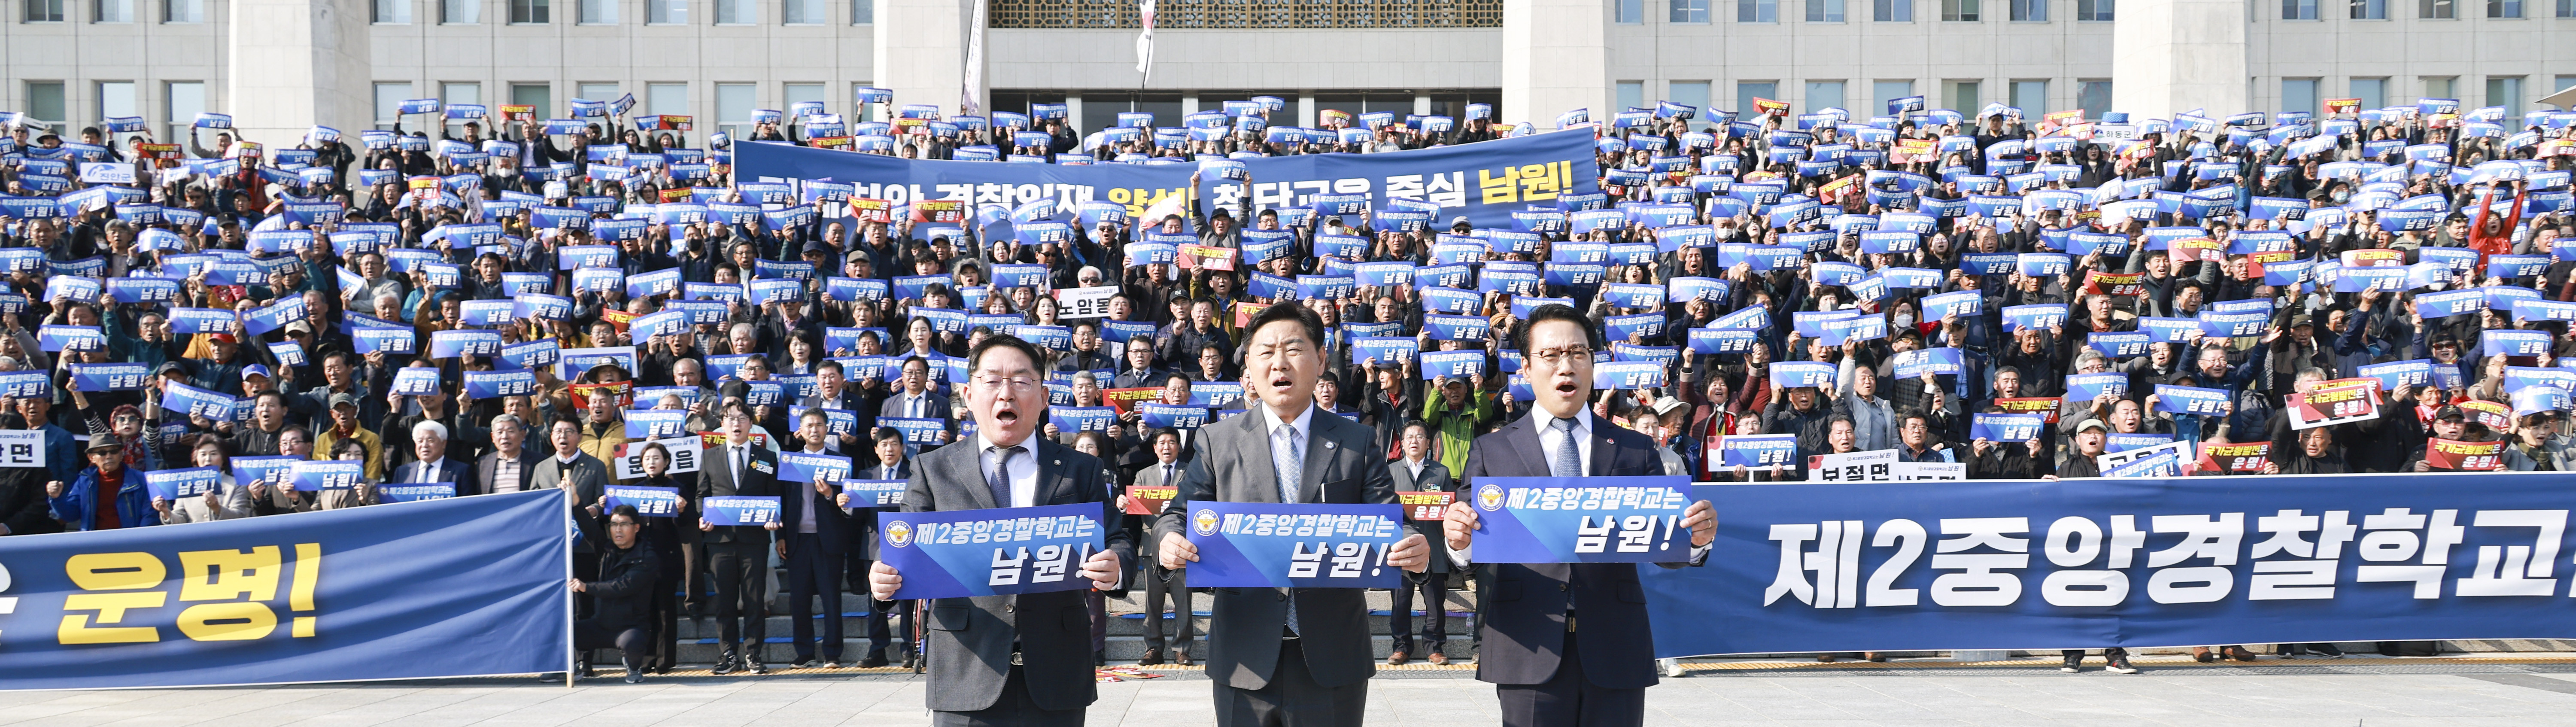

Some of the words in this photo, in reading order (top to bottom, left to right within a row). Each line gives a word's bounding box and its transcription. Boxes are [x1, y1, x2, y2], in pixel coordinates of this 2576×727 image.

[1905, 103, 1921, 111] 남원!
[2106, 130, 2131, 138] 하동군
[100, 172, 131, 181] 진안군
[1221, 168, 1245, 178] 남원!
[1479, 160, 1572, 205] 남원!
[1754, 192, 1778, 203] 남원!
[1977, 196, 2021, 204] 제2중앙경찰학교는
[915, 202, 962, 210] 국가균형발전은
[1338, 203, 1363, 213] 남원!
[2260, 200, 2309, 208] 제2중앙경찰학교는
[25, 206, 53, 217] 남원!
[935, 210, 960, 221] 운명!
[1100, 210, 1124, 221] 남원!
[1994, 205, 2020, 216] 남원!
[2279, 208, 2305, 219] 남원!
[2387, 211, 2434, 219] 제2중앙경찰학교는
[1401, 219, 1425, 230] 남원!
[1667, 214, 1692, 225] 남원!
[2406, 219, 2433, 229] 남원!
[619, 228, 644, 238] 남원!
[2077, 234, 2127, 244] 제2중앙경찰학교는
[1888, 240, 1915, 250] 남원!
[2257, 241, 2286, 252] 남원!
[1183, 247, 1232, 259] 국가균형발전은
[1340, 245, 1365, 257] 남원!
[1580, 252, 1607, 262] 남원!
[1204, 258, 1229, 269] 운명!
[1554, 264, 1603, 272] 제2중앙경찰학교는
[999, 266, 1045, 274] 제2중앙경찰학교는
[2348, 269, 2406, 277] 제2중앙경찰학교는
[1019, 274, 1044, 285] 남원!
[1306, 277, 1354, 286] 제2중앙경찰학교는
[1384, 273, 1411, 283] 남원!
[1573, 272, 1600, 283] 남원!
[2092, 274, 2142, 284] 국가균형발전은
[2371, 277, 2403, 289] 남원!
[653, 278, 678, 293] 남원!
[837, 279, 886, 289] 제2중앙경찰학교는
[2112, 284, 2140, 294] 운명!
[141, 288, 173, 299] 남원!
[855, 289, 884, 301] 남원!
[1325, 286, 1352, 297] 남원!
[2427, 290, 2483, 304] 제2중앙경찰학교는
[1929, 293, 1978, 305] 제2중앙경찰학교는
[1947, 302, 1976, 314] 남원!
[2451, 298, 2482, 313] 남원!
[695, 310, 724, 323] 남원!
[918, 309, 966, 320] 제2중앙경찰학교는
[2013, 307, 2066, 316] 제2중앙경찰학교는
[1434, 317, 1487, 327] 제2중앙경찰학교는
[1616, 314, 1663, 325] 제2중앙경찰학교는
[1829, 317, 1881, 329] 제2중앙경찰학교는
[2034, 315, 2064, 329] 남원!
[2211, 313, 2266, 322] 제2중앙경찰학교는
[655, 320, 683, 335] 남원!
[937, 319, 964, 332] 남원!
[1637, 323, 1662, 337] 남원!
[2233, 322, 2263, 335] 남원!
[442, 332, 499, 341] 제2중앙경찰학교는
[1455, 327, 1483, 339] 남원!
[1850, 326, 1881, 341] 남원!
[2497, 332, 2549, 341] 제2중앙경찰학교는
[464, 341, 497, 354] 남원!
[1720, 338, 1752, 351] 남원!
[2118, 342, 2148, 354] 남원!
[2518, 341, 2548, 354] 남원!
[1384, 348, 1413, 361] 남원!
[1431, 352, 1483, 363] 제2중앙경찰학교는
[82, 365, 146, 374] 제2중앙경찰학교는
[1453, 362, 1482, 374] 남원!
[1604, 363, 1661, 372] 제2중앙경찰학교는
[2372, 363, 2428, 374] 제2중앙경찰학교는
[109, 374, 144, 387] 남원!
[1626, 372, 1657, 385] 남원!
[2398, 371, 2427, 384] 남원!
[173, 387, 231, 405] 제2중앙경찰학교는
[1109, 391, 1163, 400] 국가균형발전은
[2166, 388, 2225, 400] 제2중앙경찰학교는
[2304, 389, 2365, 405] 국가균형발전은
[191, 399, 228, 420] 남원!
[2187, 398, 2222, 413] 남원!
[2334, 400, 2364, 414] 운명!
[1059, 408, 1113, 417] 제2중앙경찰학교는
[1152, 406, 1206, 417] 제2중앙경찰학교는
[887, 420, 942, 429] 제2중앙경찰학교는
[1081, 417, 1111, 430] 남원!
[1174, 416, 1205, 427] 남원!
[1984, 417, 2040, 426] 제2중앙경찰학교는
[909, 429, 941, 442] 남원!
[2004, 427, 2037, 440] 남원!
[1736, 440, 1794, 449] 제2중앙경찰학교는
[2435, 442, 2501, 455] 국가균형발전은
[1759, 449, 1791, 463] 남원!
[2205, 445, 2268, 456] 국가균형발전은
[791, 456, 848, 468] 제2중앙경찰학교는
[2232, 457, 2265, 469] 운명!
[2462, 456, 2497, 468] 운명!
[154, 469, 217, 483] 제2중앙경찰학교는
[323, 473, 356, 487] 남원!
[815, 467, 846, 482] 남원!
[178, 479, 215, 496] 남원!
[616, 489, 676, 498] 제2중앙경찰학교는
[1506, 487, 1683, 511] 제2중앙경찰학교는
[639, 500, 672, 514] 남원!
[715, 499, 778, 509] 제2중앙경찰학교는
[739, 509, 775, 522] 남원!
[1415, 506, 1447, 519] 운명!
[915, 514, 1096, 545] 제2중앙경찰학교는
[1220, 514, 1395, 538] 제2중앙경찰학교는
[1574, 515, 1677, 553] 남원!
[989, 542, 1089, 585] 남원!
[1288, 541, 1391, 578] 남원!
[1763, 508, 2576, 610] 제2중앙경찰학교
[58, 542, 321, 644] 운명!
